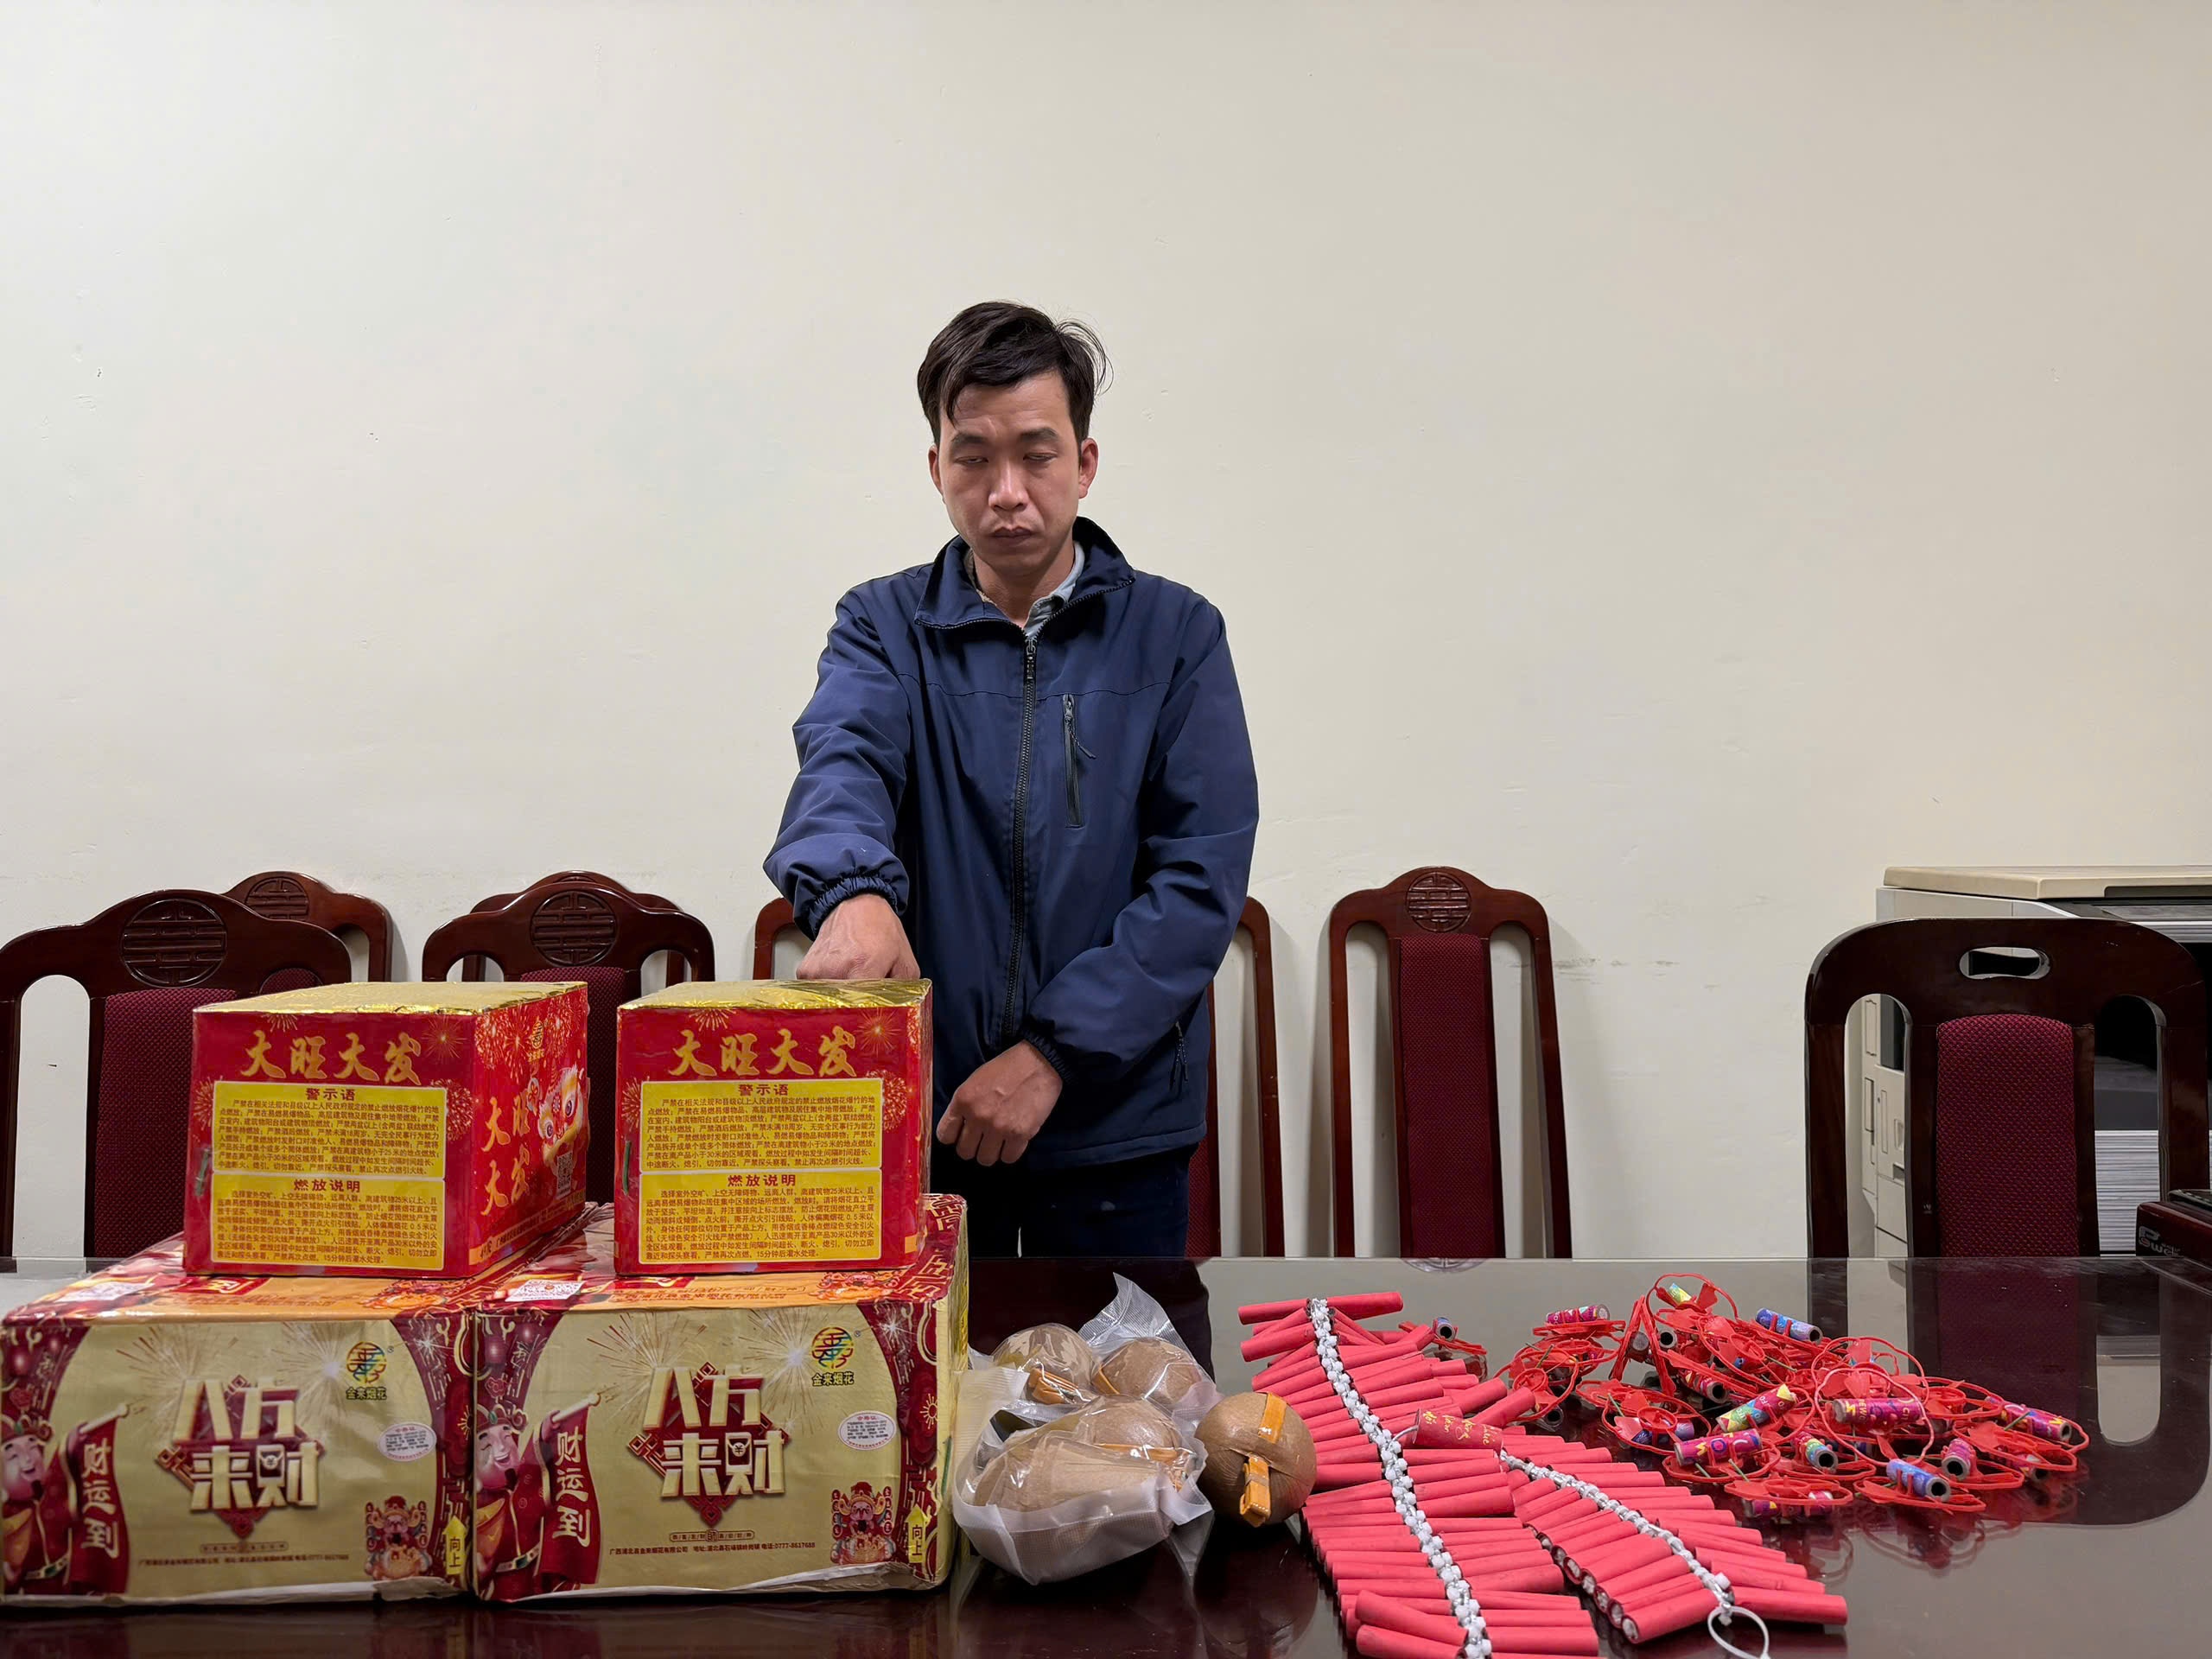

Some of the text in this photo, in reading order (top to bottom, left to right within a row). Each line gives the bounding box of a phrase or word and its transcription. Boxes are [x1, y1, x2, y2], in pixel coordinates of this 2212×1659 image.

[240, 1029, 422, 1085] 大旺大发
[668, 1026, 857, 1077] 大旺大发
[306, 1088, 355, 1101] 警示语
[738, 1084, 788, 1096] 警示语
[294, 1179, 360, 1192] 燃放说明
[728, 1174, 796, 1186] 燃放说明
[346, 1386, 387, 1400] 金来烟花
[643, 1364, 764, 1430] 八方
[811, 1371, 854, 1386] 金来烟花
[173, 1379, 301, 1440] 八方
[190, 1442, 319, 1511] 来财
[662, 1431, 785, 1497] 来财
[80, 1438, 119, 1559] 财运到
[552, 1426, 591, 1548] 财运到
[450, 1536, 461, 1567] 向上
[912, 1524, 923, 1556] 向上
